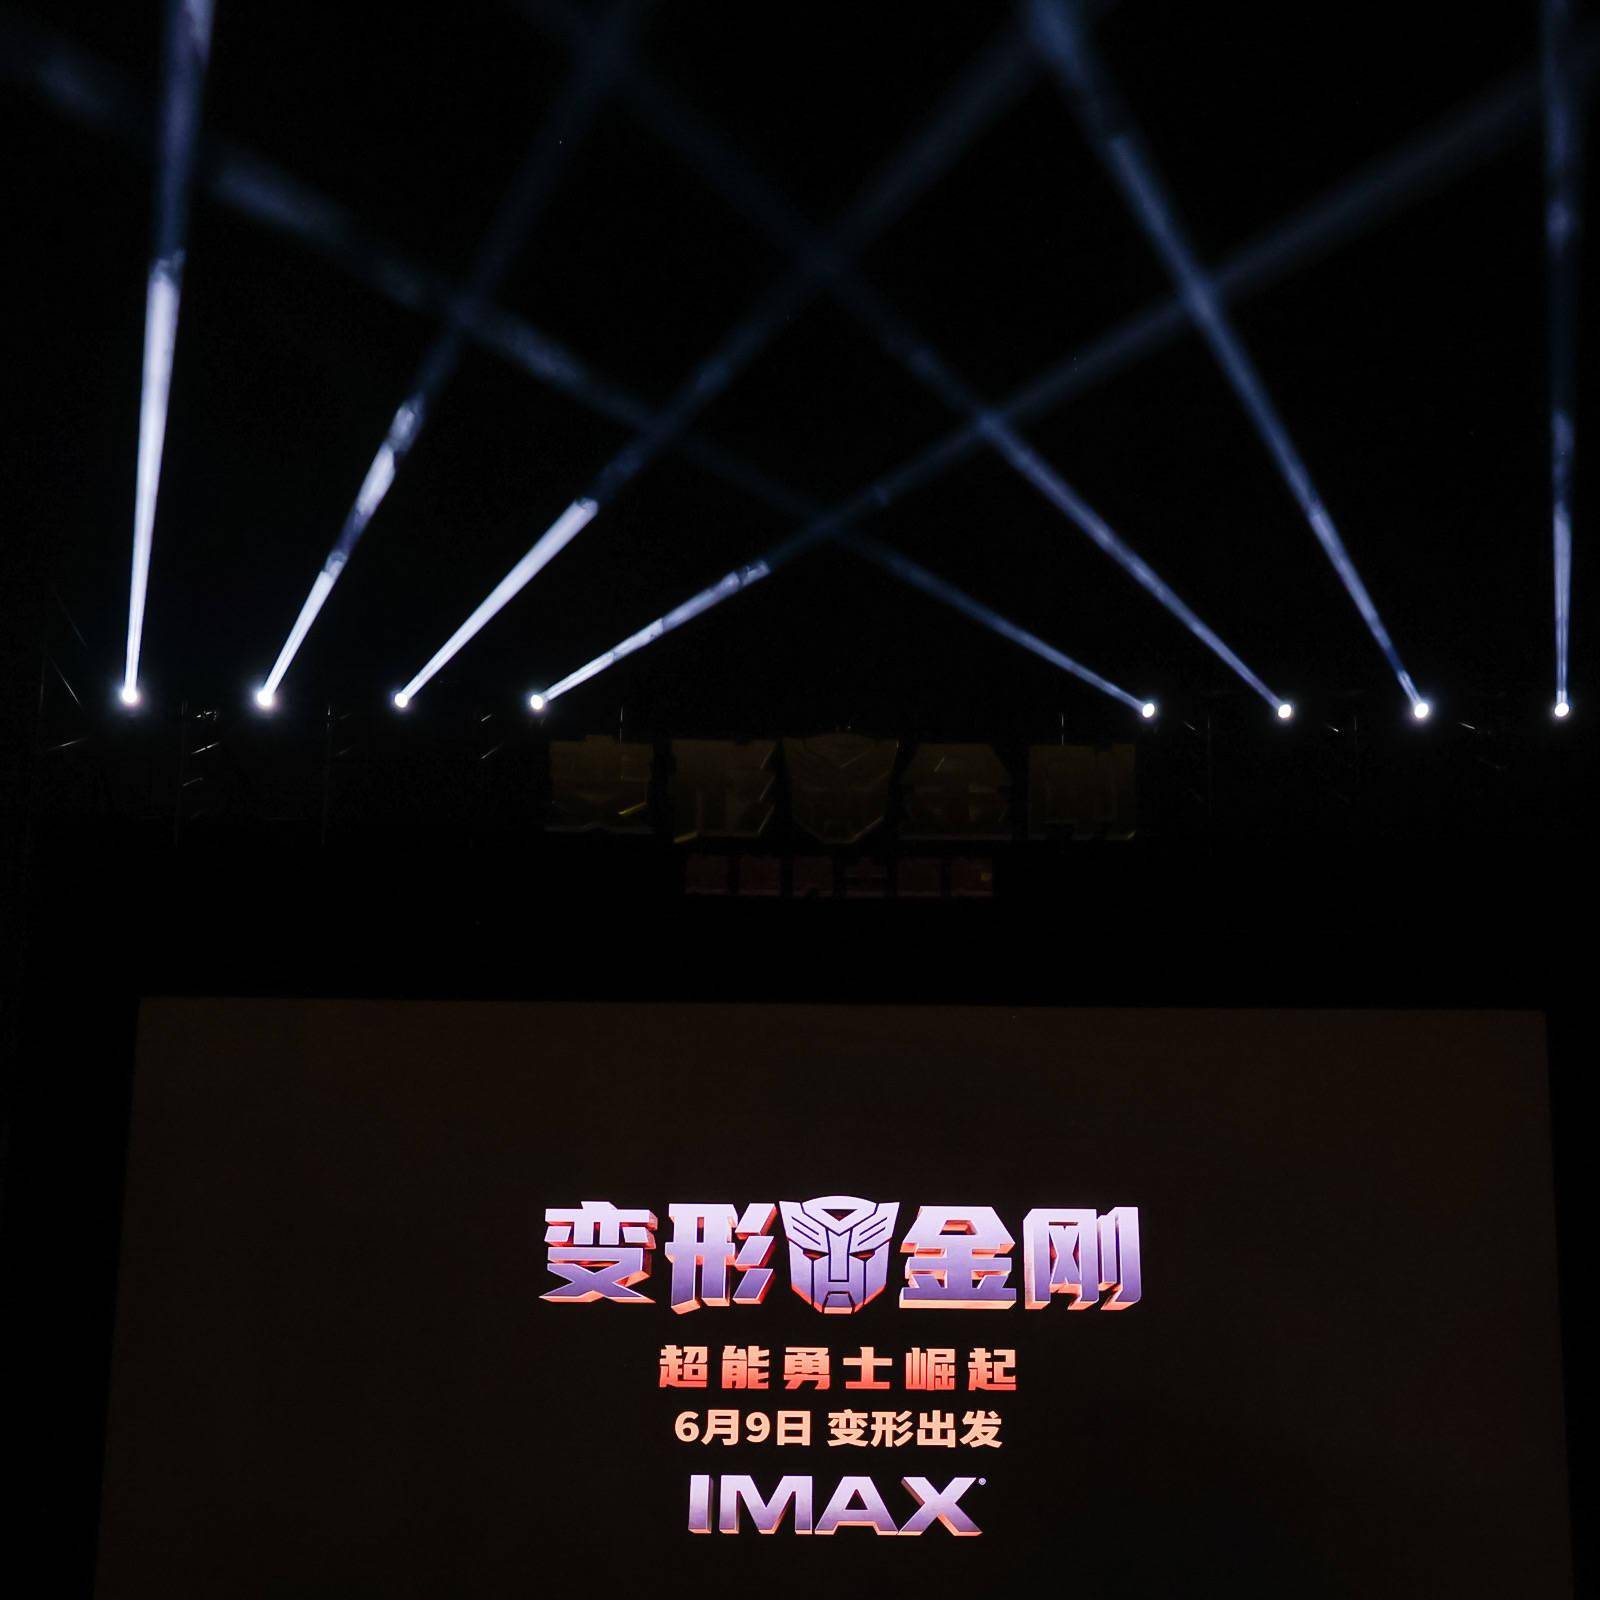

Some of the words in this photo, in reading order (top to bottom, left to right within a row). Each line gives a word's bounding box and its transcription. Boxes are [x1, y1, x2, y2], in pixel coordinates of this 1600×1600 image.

[658, 1344, 1017, 1391] 超能勇士崛起
[674, 1409, 812, 1446] 6月9日
[826, 1409, 1002, 1448] 变形出发
